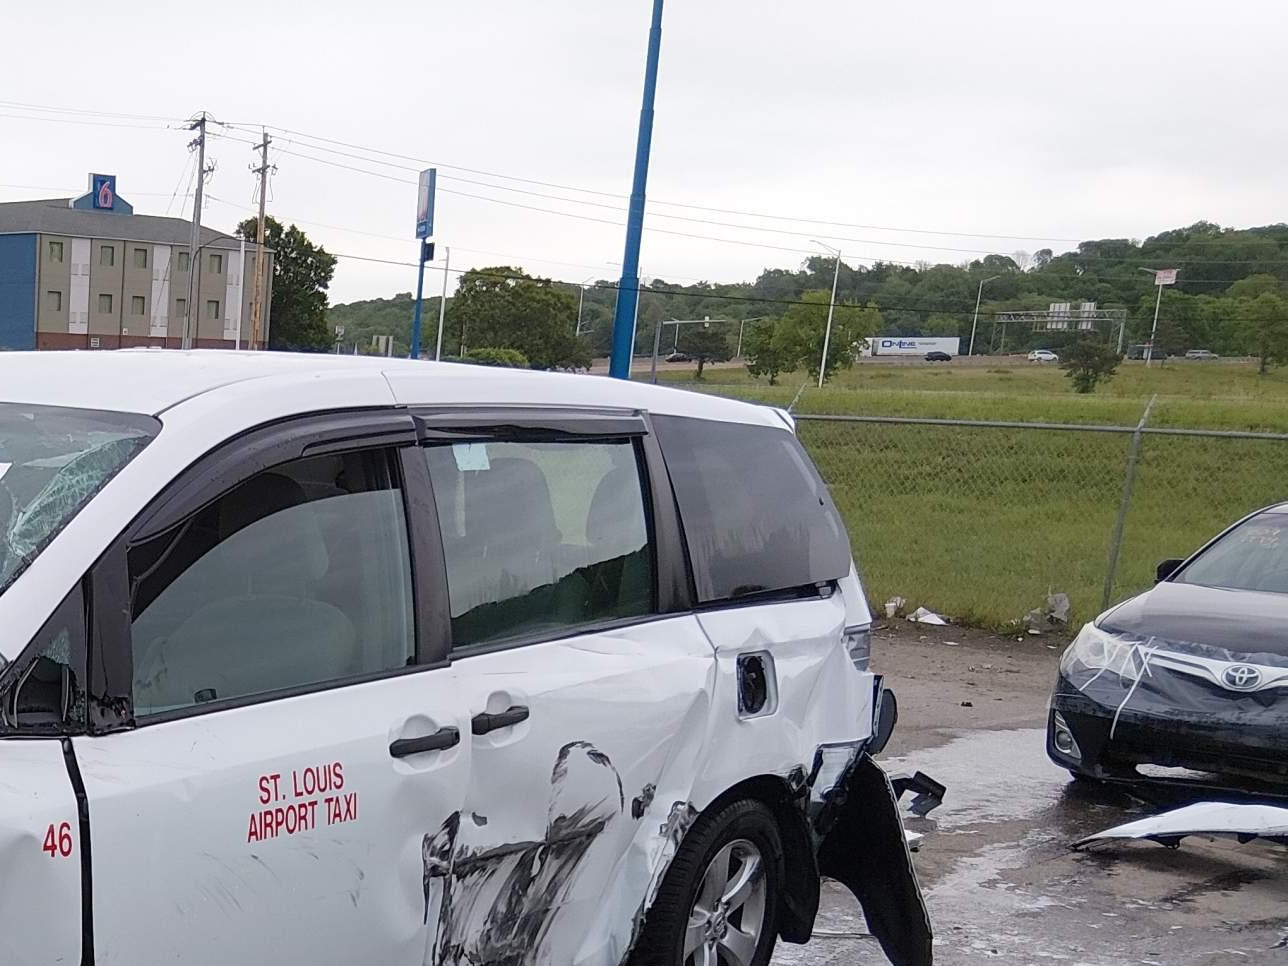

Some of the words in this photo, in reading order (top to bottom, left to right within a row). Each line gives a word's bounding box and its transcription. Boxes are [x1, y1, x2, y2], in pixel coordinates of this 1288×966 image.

[99, 181, 113, 208] 6
[259, 773, 286, 805] ST.
[293, 761, 344, 798] LOUIS
[247, 800, 319, 844] AIRPORT
[324, 792, 358, 826] TAXI
[42, 821, 73, 858] 46
